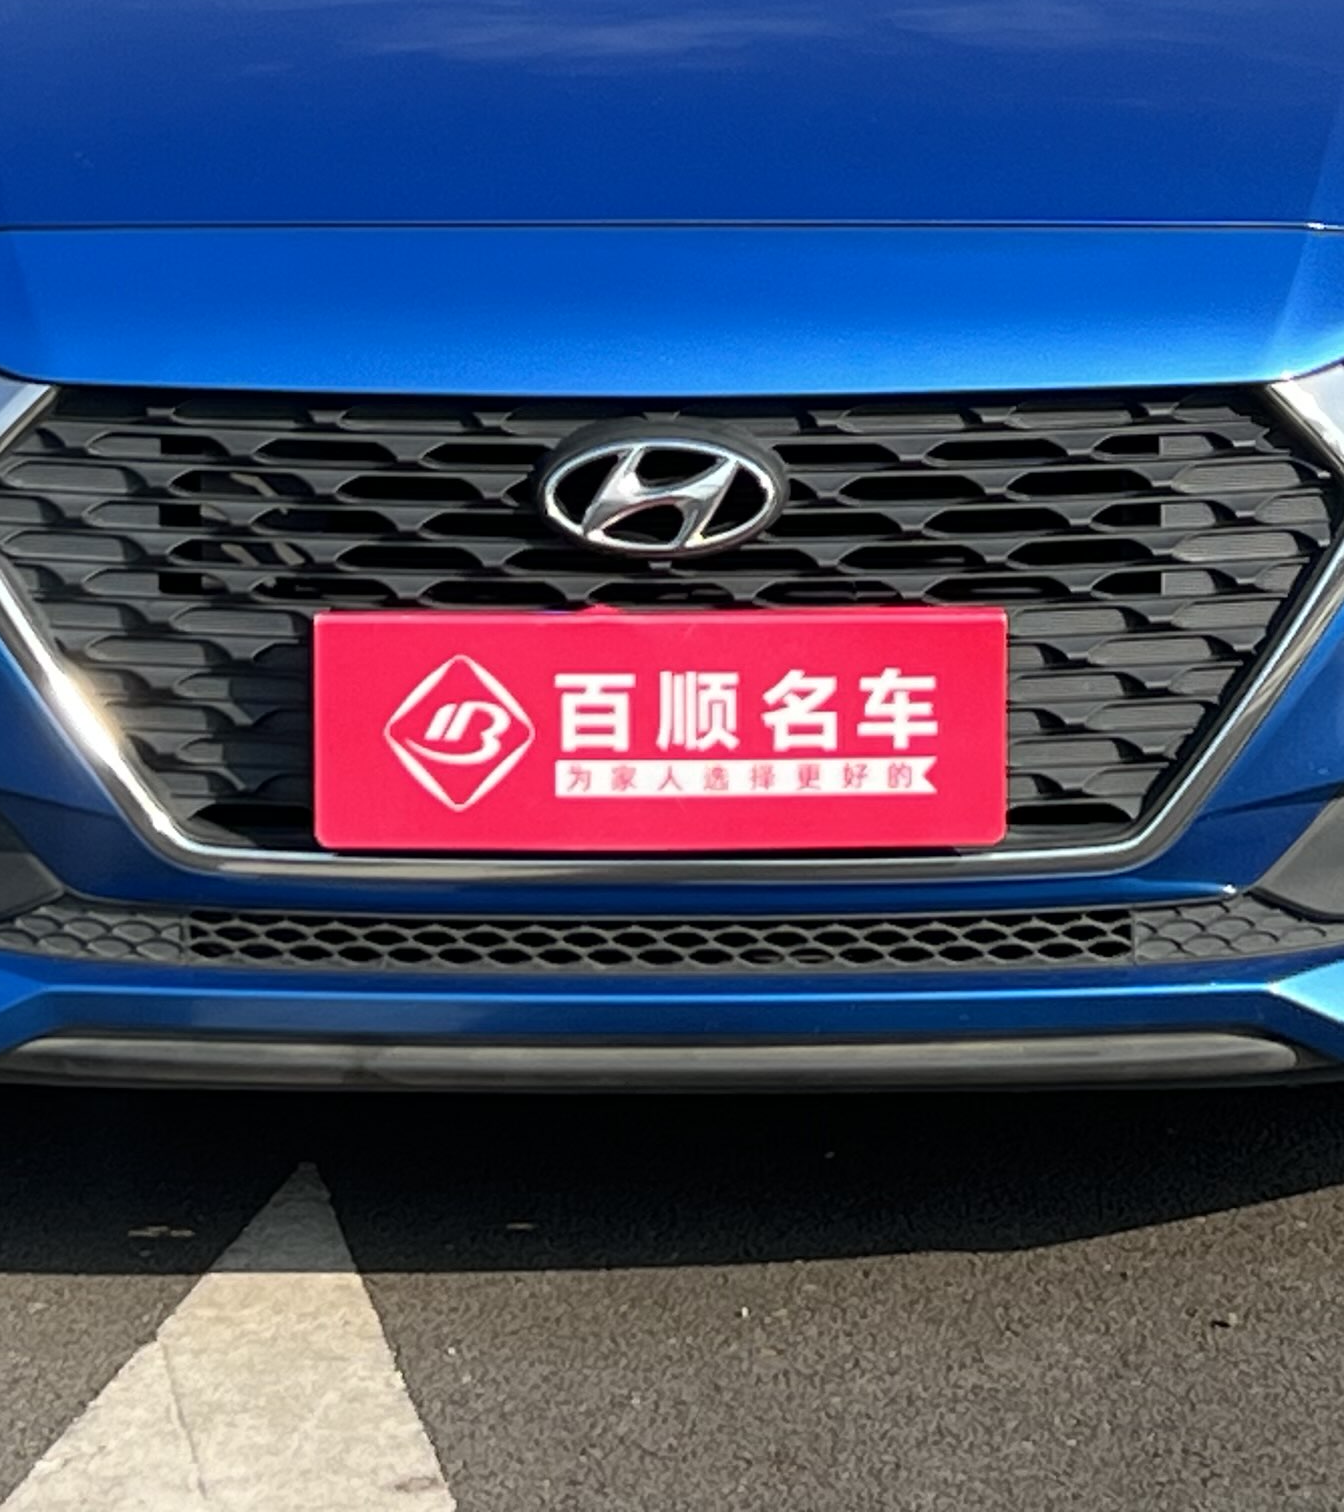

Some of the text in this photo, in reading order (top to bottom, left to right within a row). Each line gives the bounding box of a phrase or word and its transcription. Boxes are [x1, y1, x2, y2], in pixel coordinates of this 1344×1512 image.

[554, 668, 939, 752] 百顺名车
[566, 762, 913, 791] 为家人选择更好的
